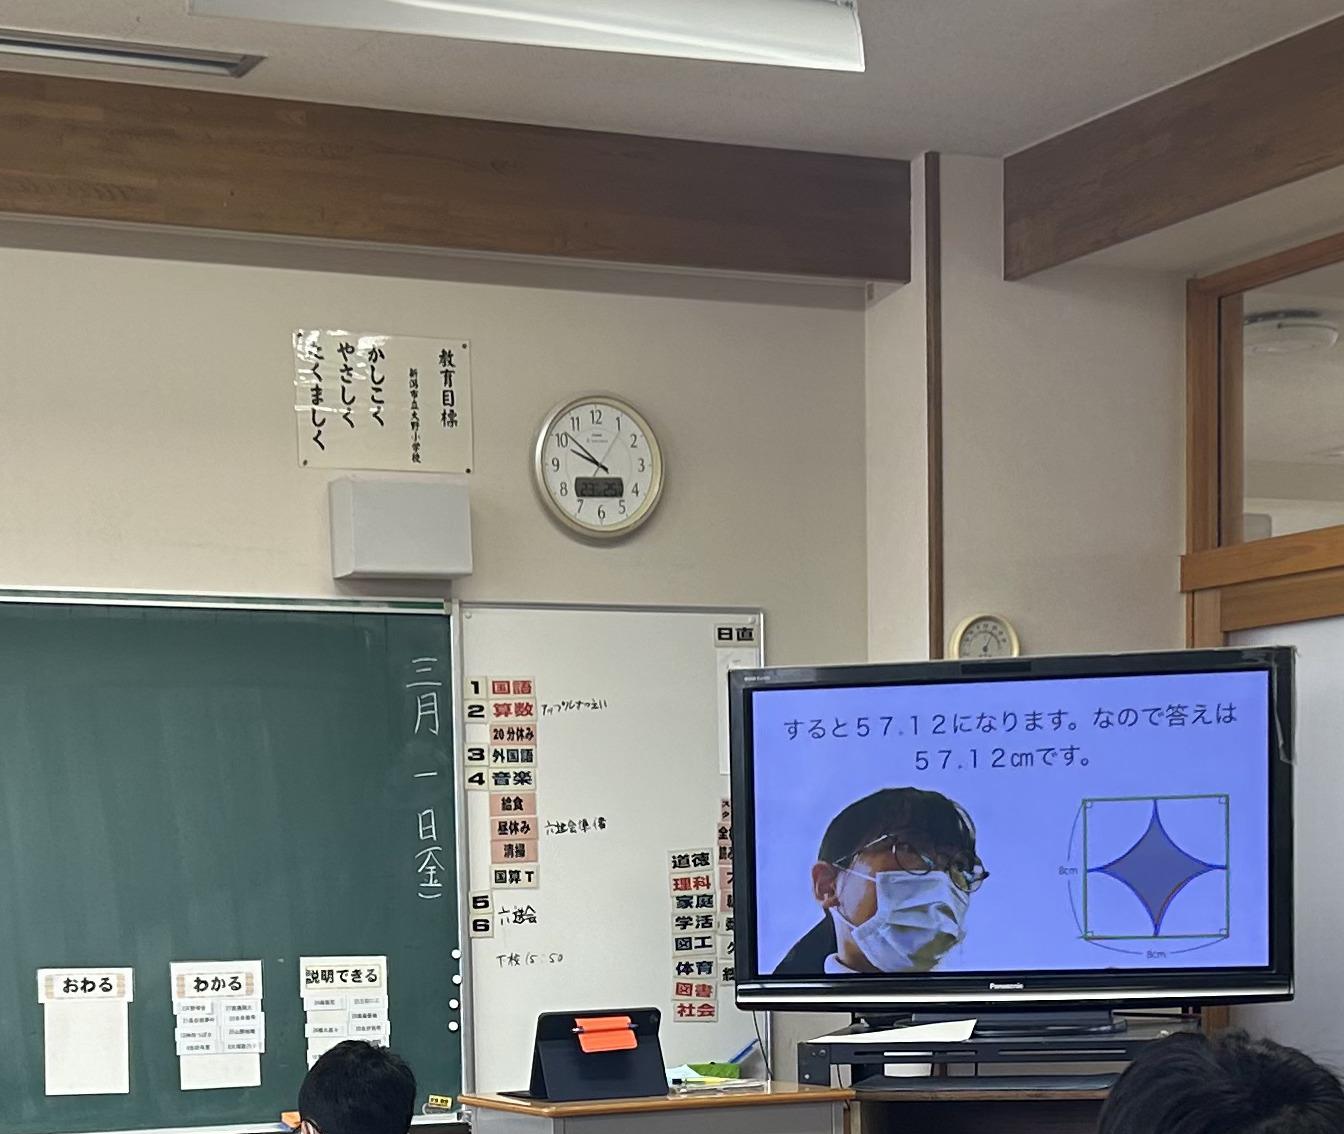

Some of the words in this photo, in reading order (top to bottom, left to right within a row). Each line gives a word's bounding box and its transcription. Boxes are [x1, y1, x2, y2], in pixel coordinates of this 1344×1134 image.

[337, 341, 356, 429] やさしく
[367, 345, 386, 427] かしこく
[438, 348, 458, 428] 教育目標
[570, 416, 580, 432] 11
[589, 409, 602, 425] 12
[615, 416, 621, 432] 1
[555, 432, 569, 448] 10
[630, 433, 638, 449] 2
[551, 457, 560, 473] 9
[637, 458, 645, 473] 3
[559, 482, 568, 497] 8
[631, 482, 640, 497] 4
[577, 499, 584, 514] 7
[597, 504, 606, 520] 6
[618, 499, 626, 515] 5
[717, 626, 754, 641] 日直
[470, 680, 480, 695] 1
[491, 680, 532, 695] 国語
[467, 704, 485, 718] 2
[492, 702, 534, 718] 算数
[492, 726, 535, 742] 20分休み
[467, 747, 485, 761] 3
[492, 748, 534, 763] 外国語
[467, 771, 486, 786] 4
[491, 771, 533, 786] 音楽
[500, 796, 524, 811] 給食
[497, 820, 531, 835] 昼休み
[503, 843, 526, 858] 清掃
[671, 852, 711, 870] 道徳
[1058, 865, 1079, 876] 8cm
[672, 875, 712, 892] 理科
[472, 895, 490, 910] 5
[675, 894, 714, 909] 家庭
[472, 918, 490, 932] 6
[674, 914, 714, 931] 学活
[674, 936, 714, 952] 図工
[675, 960, 714, 976] 体育
[61, 976, 113, 993] おわる
[192, 975, 242, 992] わかる
[305, 968, 378, 985] 説明できる
[676, 982, 714, 998] 図書
[676, 1002, 716, 1018] 社会
